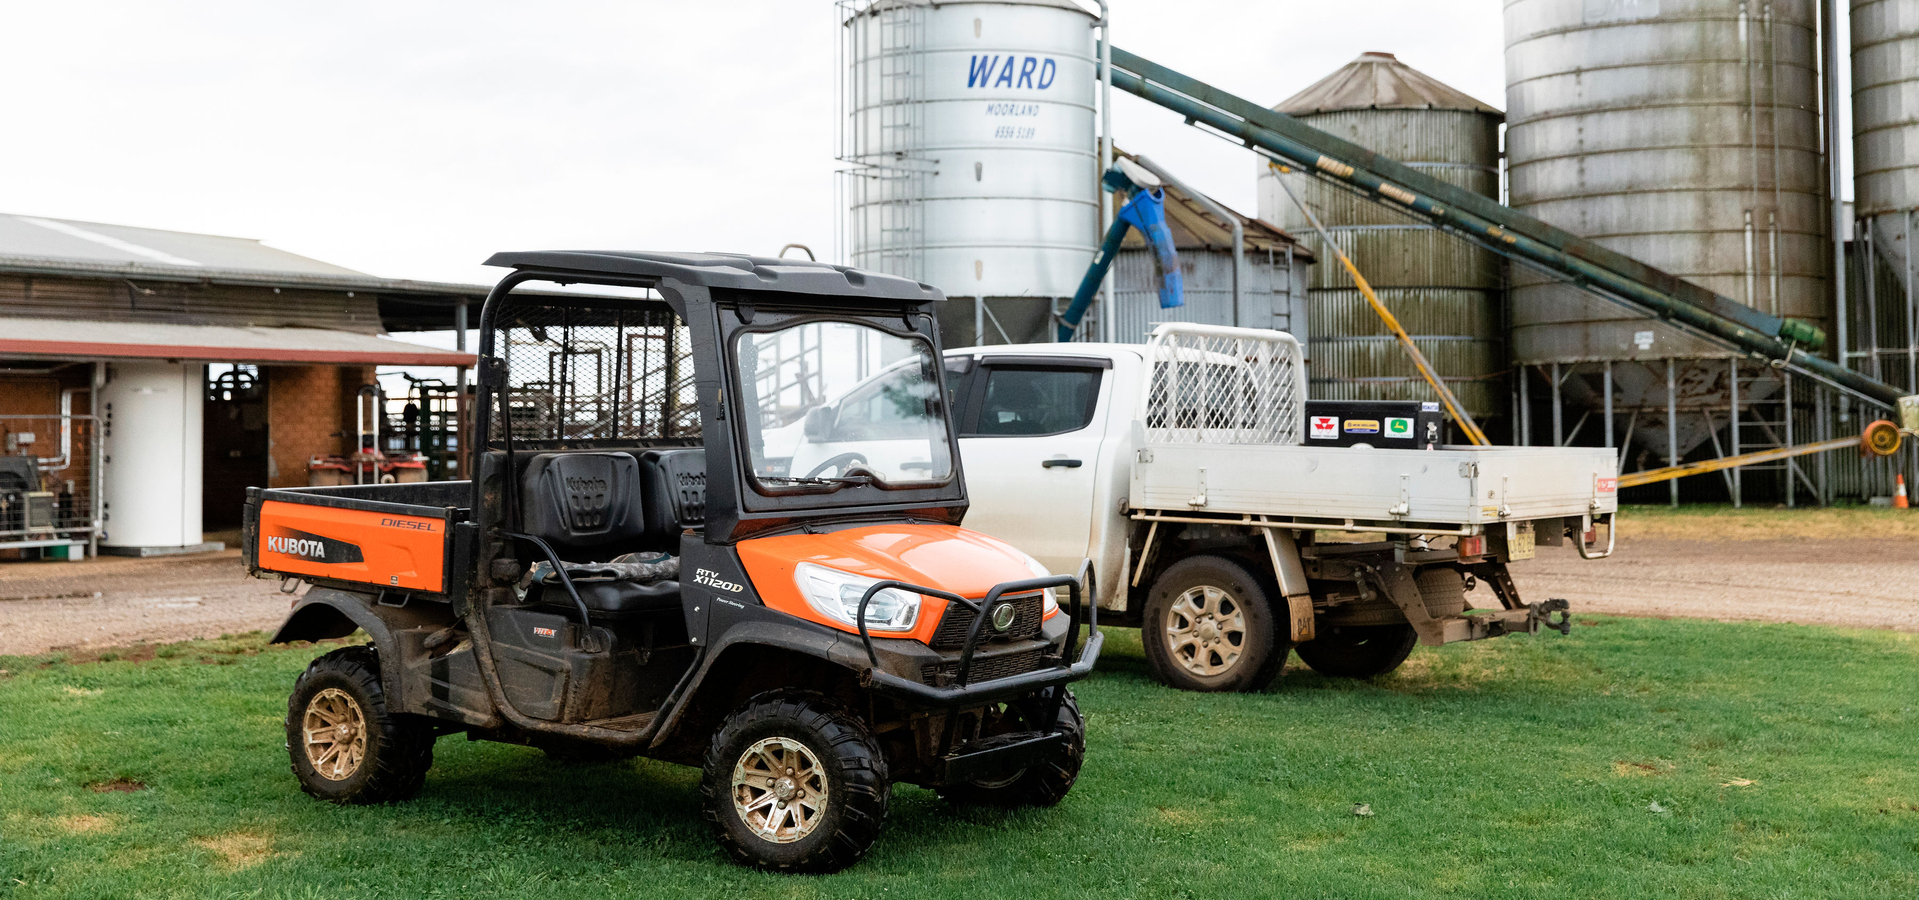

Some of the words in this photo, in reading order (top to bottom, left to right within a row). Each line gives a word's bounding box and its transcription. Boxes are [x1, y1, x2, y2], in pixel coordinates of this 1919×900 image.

[967, 55, 1056, 90] WARD
[985, 103, 1039, 117] MOORLAND
[566, 476, 608, 492] Kubota
[676, 472, 706, 486] Kubot
[381, 518, 437, 532] DIESEL
[267, 535, 326, 559] KUBOTA
[696, 568, 719, 578] RTV
[693, 574, 744, 593] X1120D
